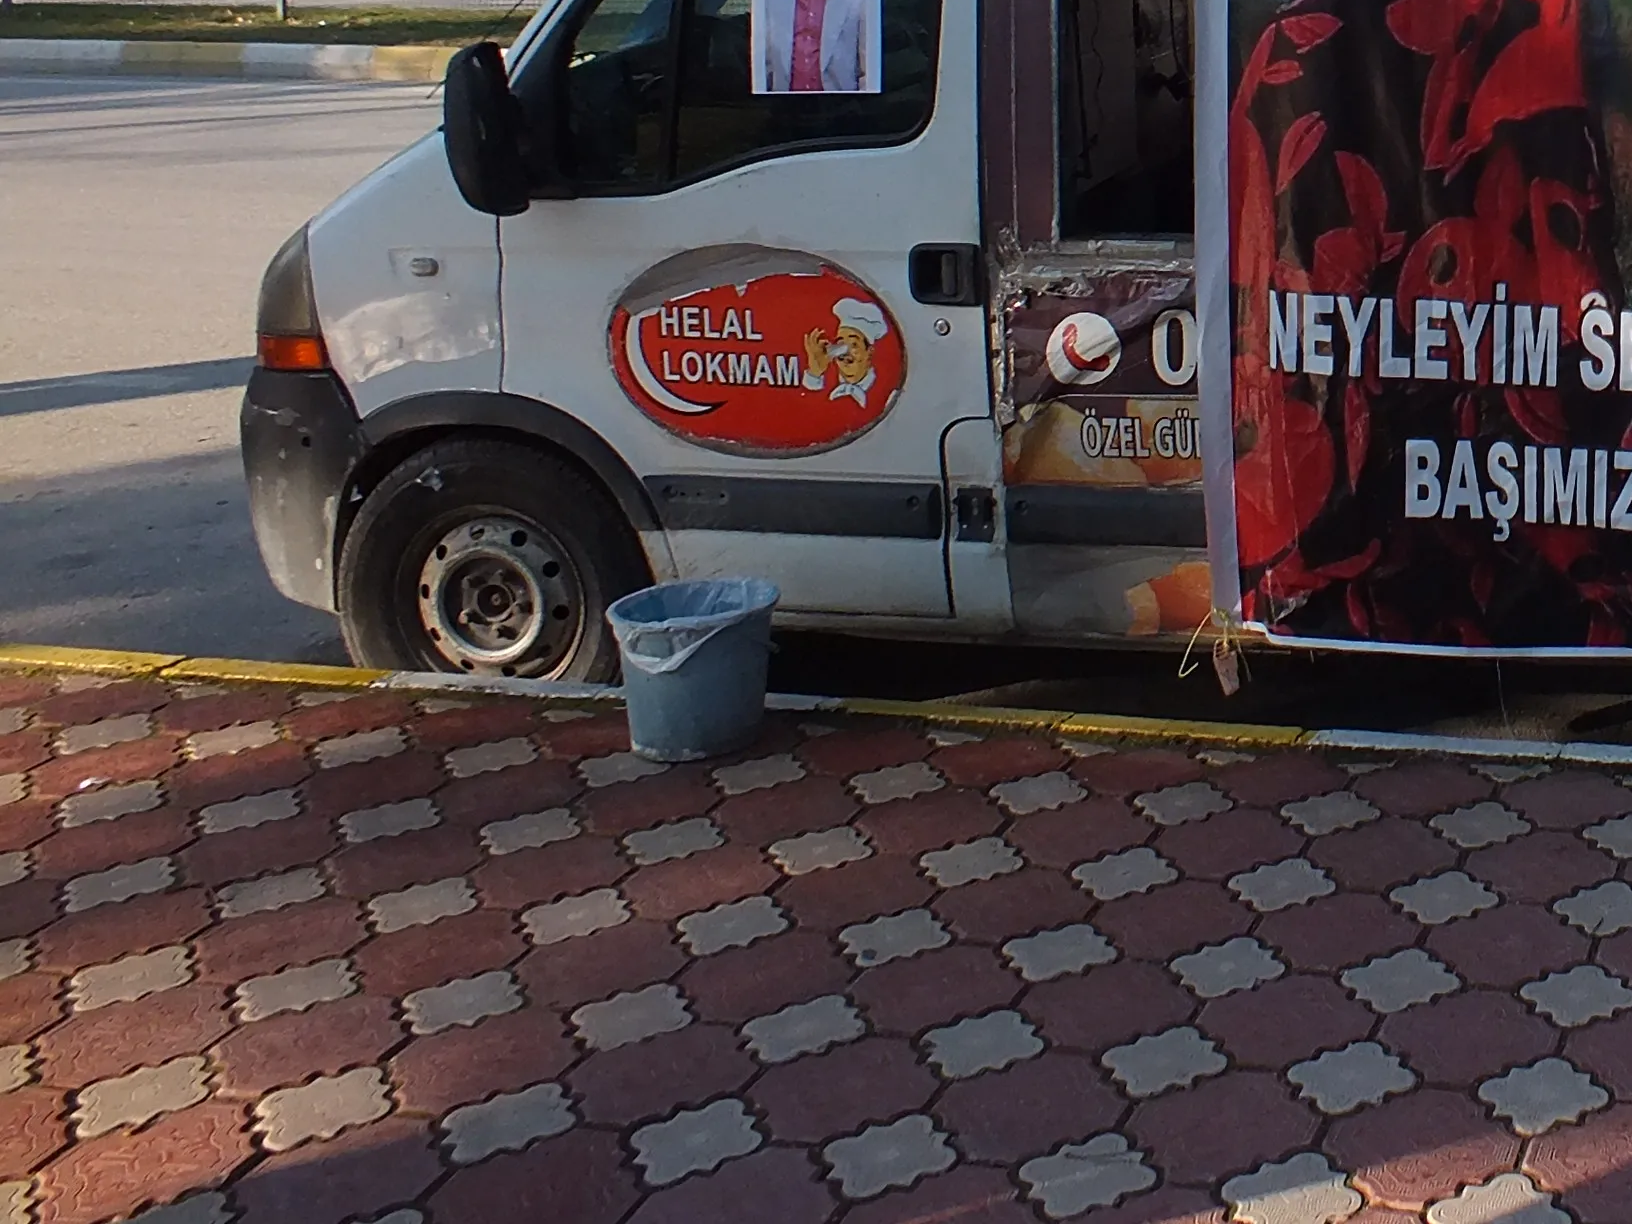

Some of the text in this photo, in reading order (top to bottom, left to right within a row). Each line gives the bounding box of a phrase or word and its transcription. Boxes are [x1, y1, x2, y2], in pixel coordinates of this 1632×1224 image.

[660, 306, 763, 341] HELAL
[1268, 283, 1558, 387] NEYLEYİM
[662, 350, 799, 386] LOKMAM
[1081, 407, 1201, 459] ÖZEL GÜ
